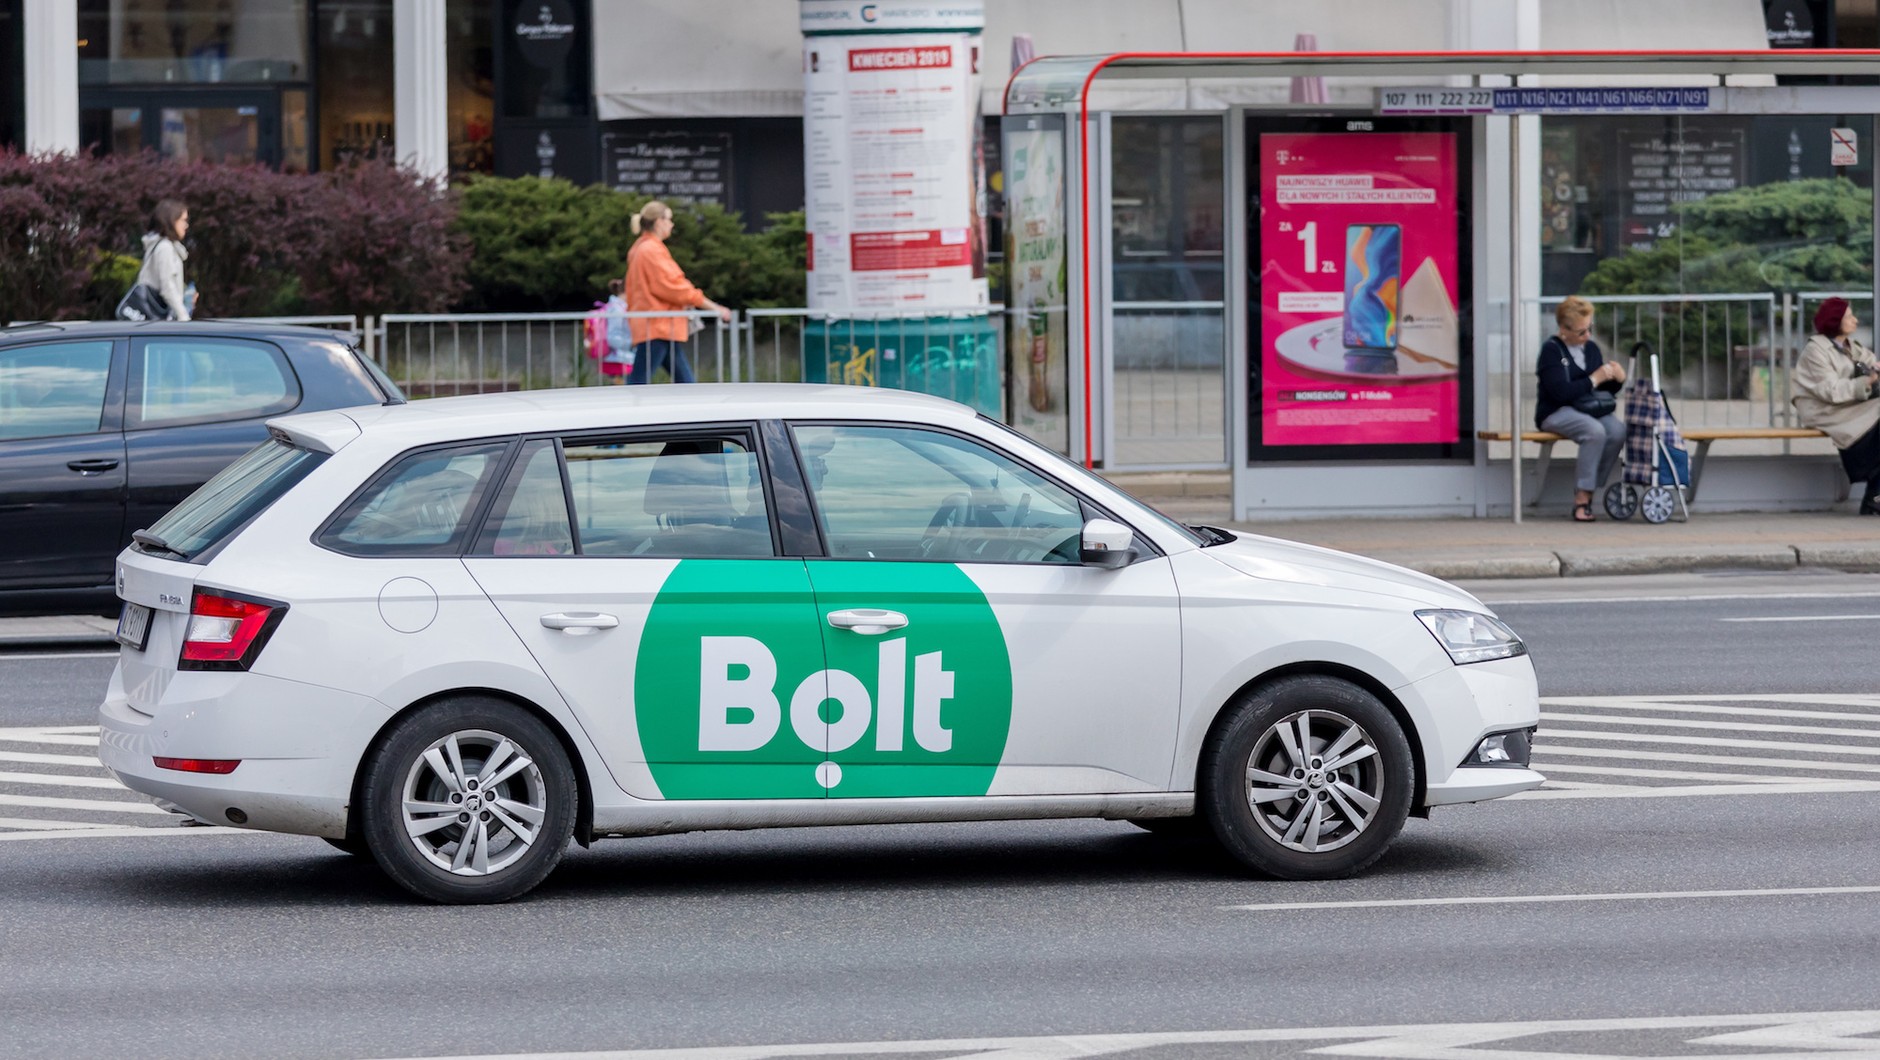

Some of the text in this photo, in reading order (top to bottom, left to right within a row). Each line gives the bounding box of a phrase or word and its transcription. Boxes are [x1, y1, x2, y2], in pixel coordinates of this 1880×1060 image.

[852, 50, 949, 68] KWIECIEŃ 2019
[1385, 91, 1708, 105] 107 111 222 227 N11 N16 N21 N41 N61 N66 N71 N91
[1346, 121, 1374, 131] ams
[1279, 178, 1371, 186] NAJNOWSZY HUAWEI
[1279, 192, 1297, 200] DLA
[1300, 192, 1339, 200] NOWYCH
[1346, 192, 1384, 200] STAŁYCH
[1386, 190, 1432, 200] KLIENTÓW
[1278, 222, 1293, 231] ZA
[1297, 221, 1317, 273] 1
[1295, 390, 1347, 400] NONSENSÓW
[1360, 390, 1393, 400] T-Mobile
[698, 635, 955, 753] Bolt
